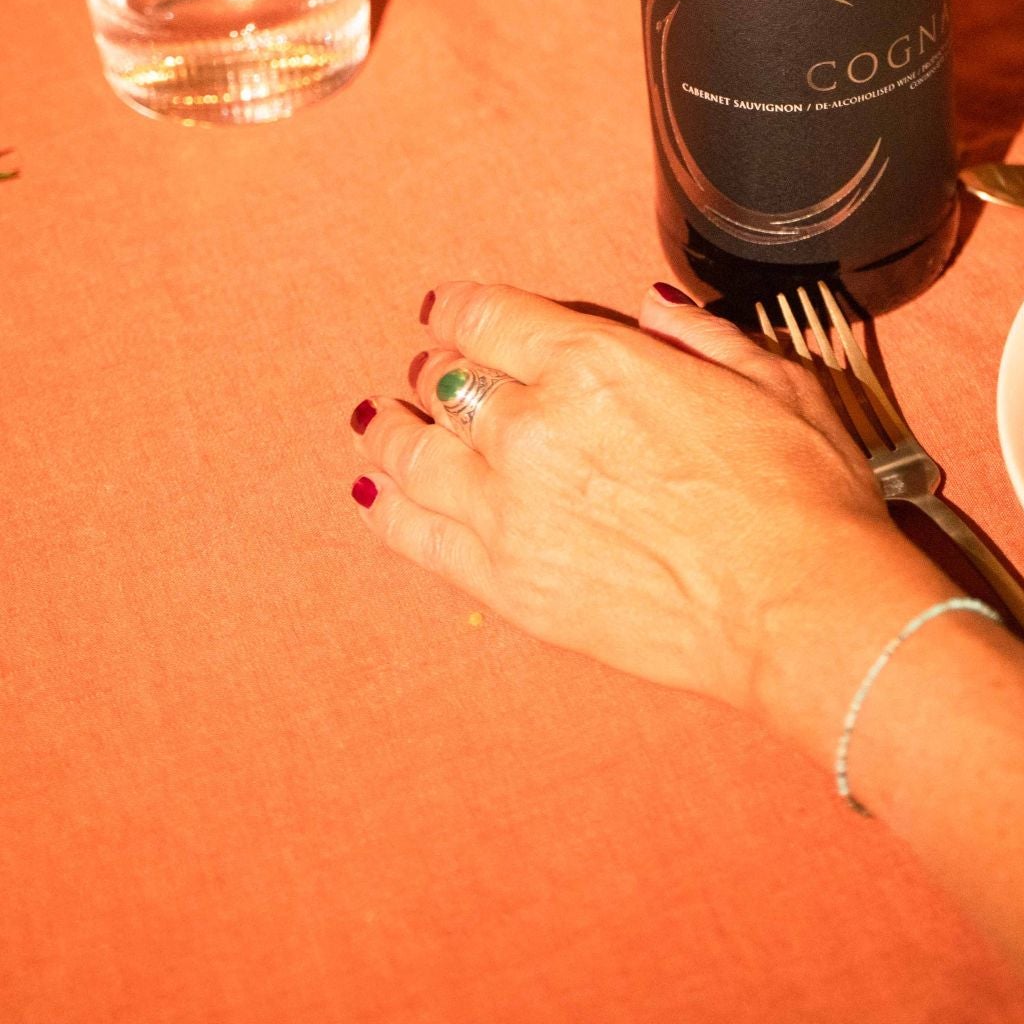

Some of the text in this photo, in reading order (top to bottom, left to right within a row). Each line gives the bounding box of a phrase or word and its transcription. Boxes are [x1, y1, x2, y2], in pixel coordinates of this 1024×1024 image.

[681, 82, 731, 106] CABERNET
[733, 99, 803, 113] SAUVIGNON
[815, 83, 896, 111] DE-ALCOHOLISED
